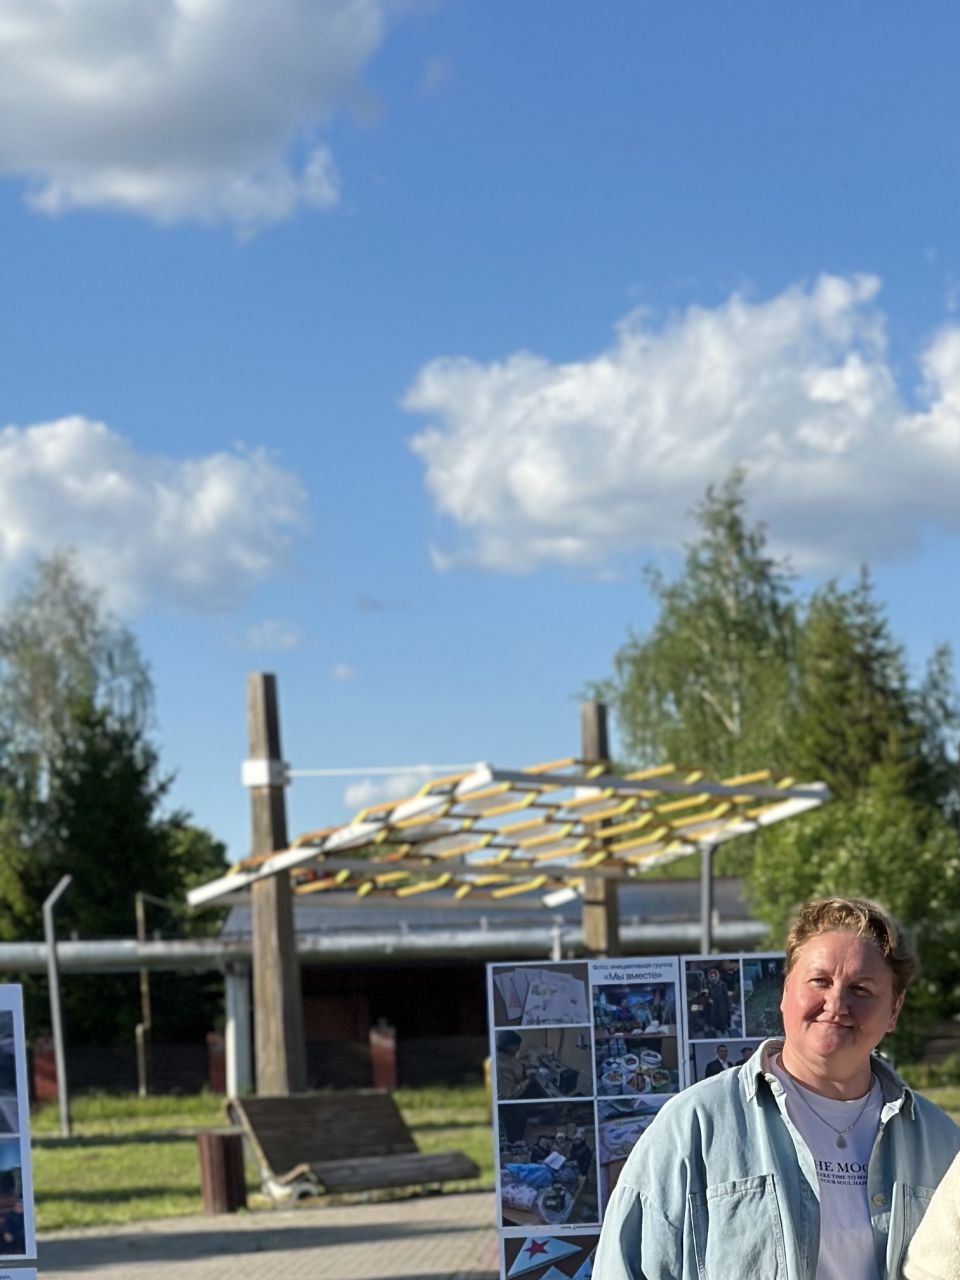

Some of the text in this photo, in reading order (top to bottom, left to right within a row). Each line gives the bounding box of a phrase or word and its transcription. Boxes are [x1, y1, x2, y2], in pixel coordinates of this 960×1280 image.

[604, 971, 663, 981] «Мы вместе»
[814, 1160, 833, 1172] HE
